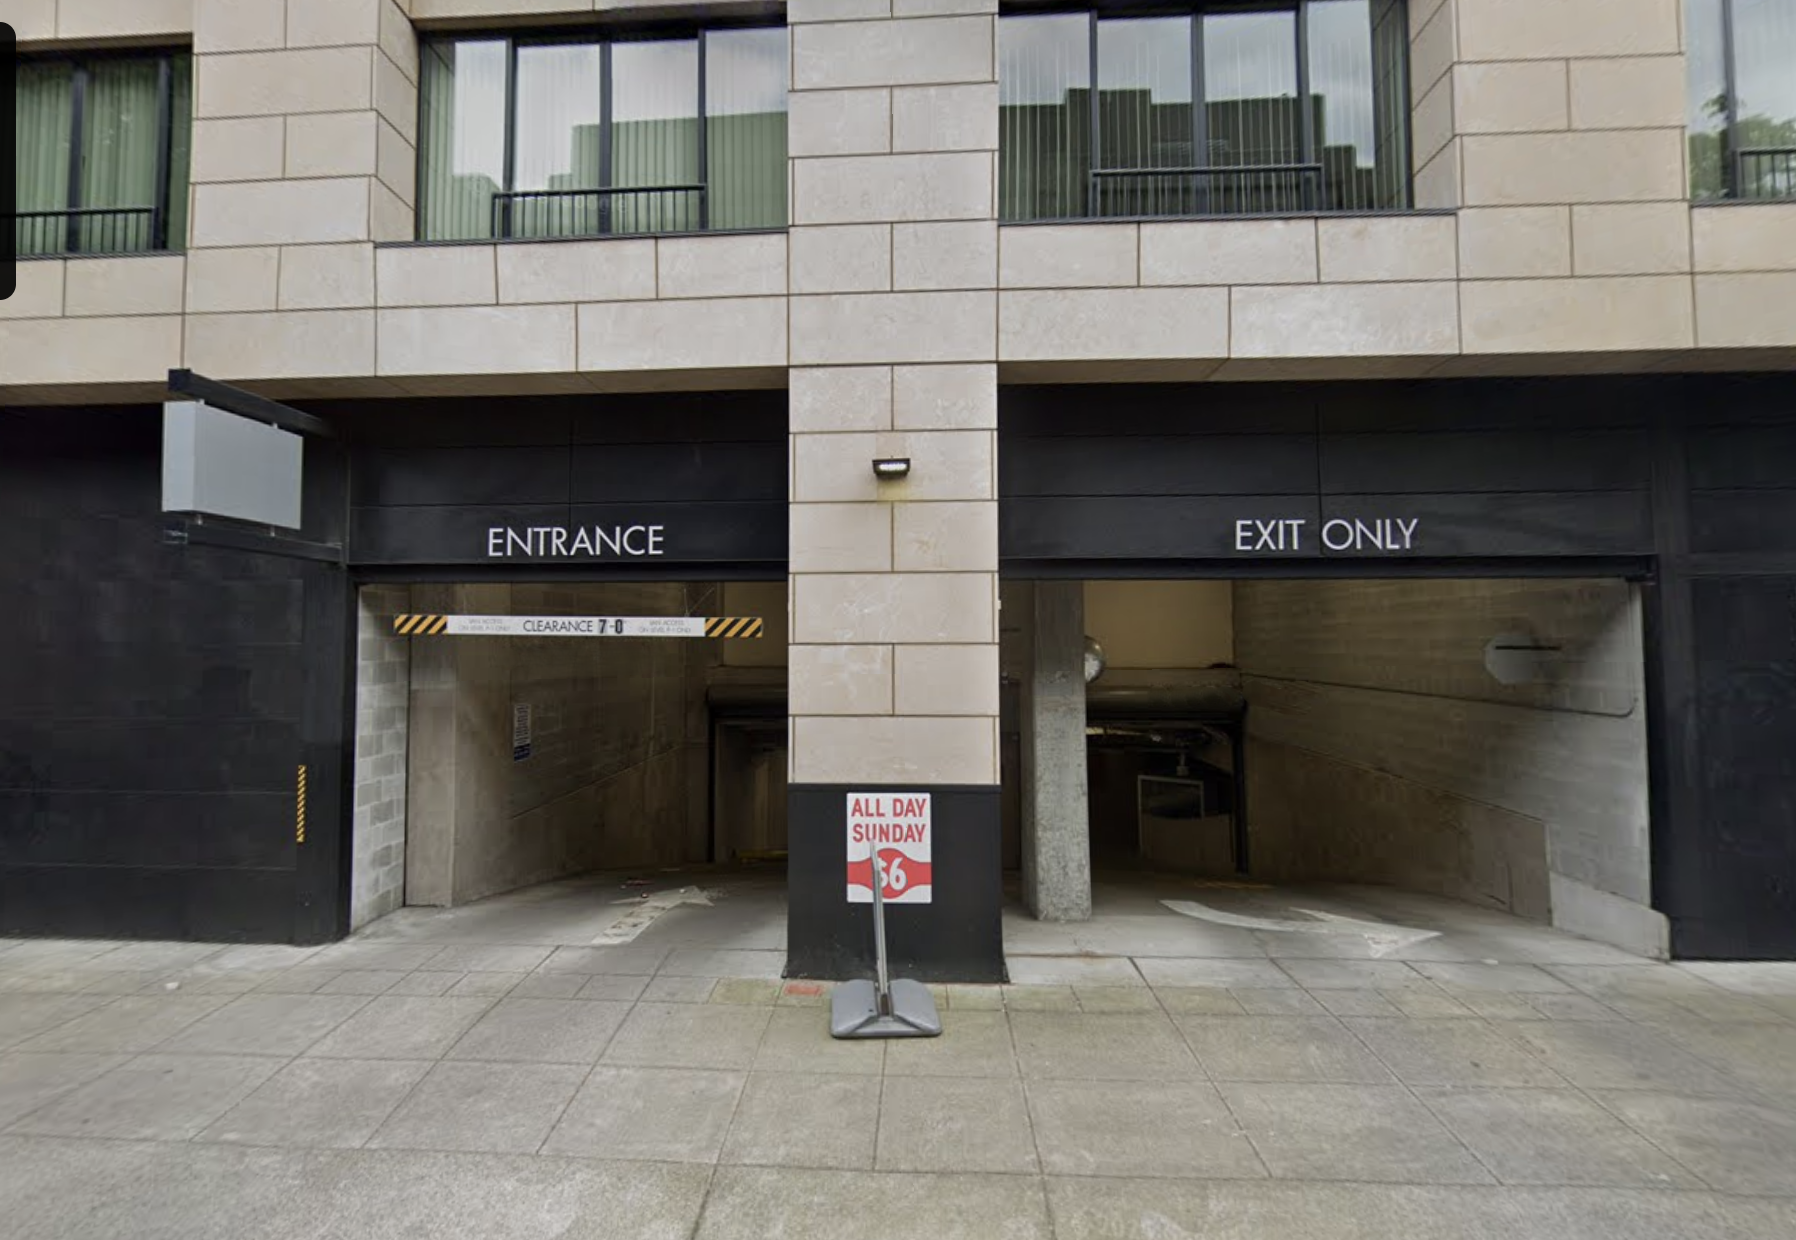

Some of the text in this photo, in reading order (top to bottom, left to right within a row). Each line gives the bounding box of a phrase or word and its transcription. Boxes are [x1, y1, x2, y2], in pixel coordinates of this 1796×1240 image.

[488, 525, 664, 557] ENTRANCE
[1235, 518, 1419, 550] EXIT ONLY
[523, 620, 593, 633] CLEARANCE
[851, 798, 927, 817] ALL DAY
[852, 823, 926, 843] SUNDAY
